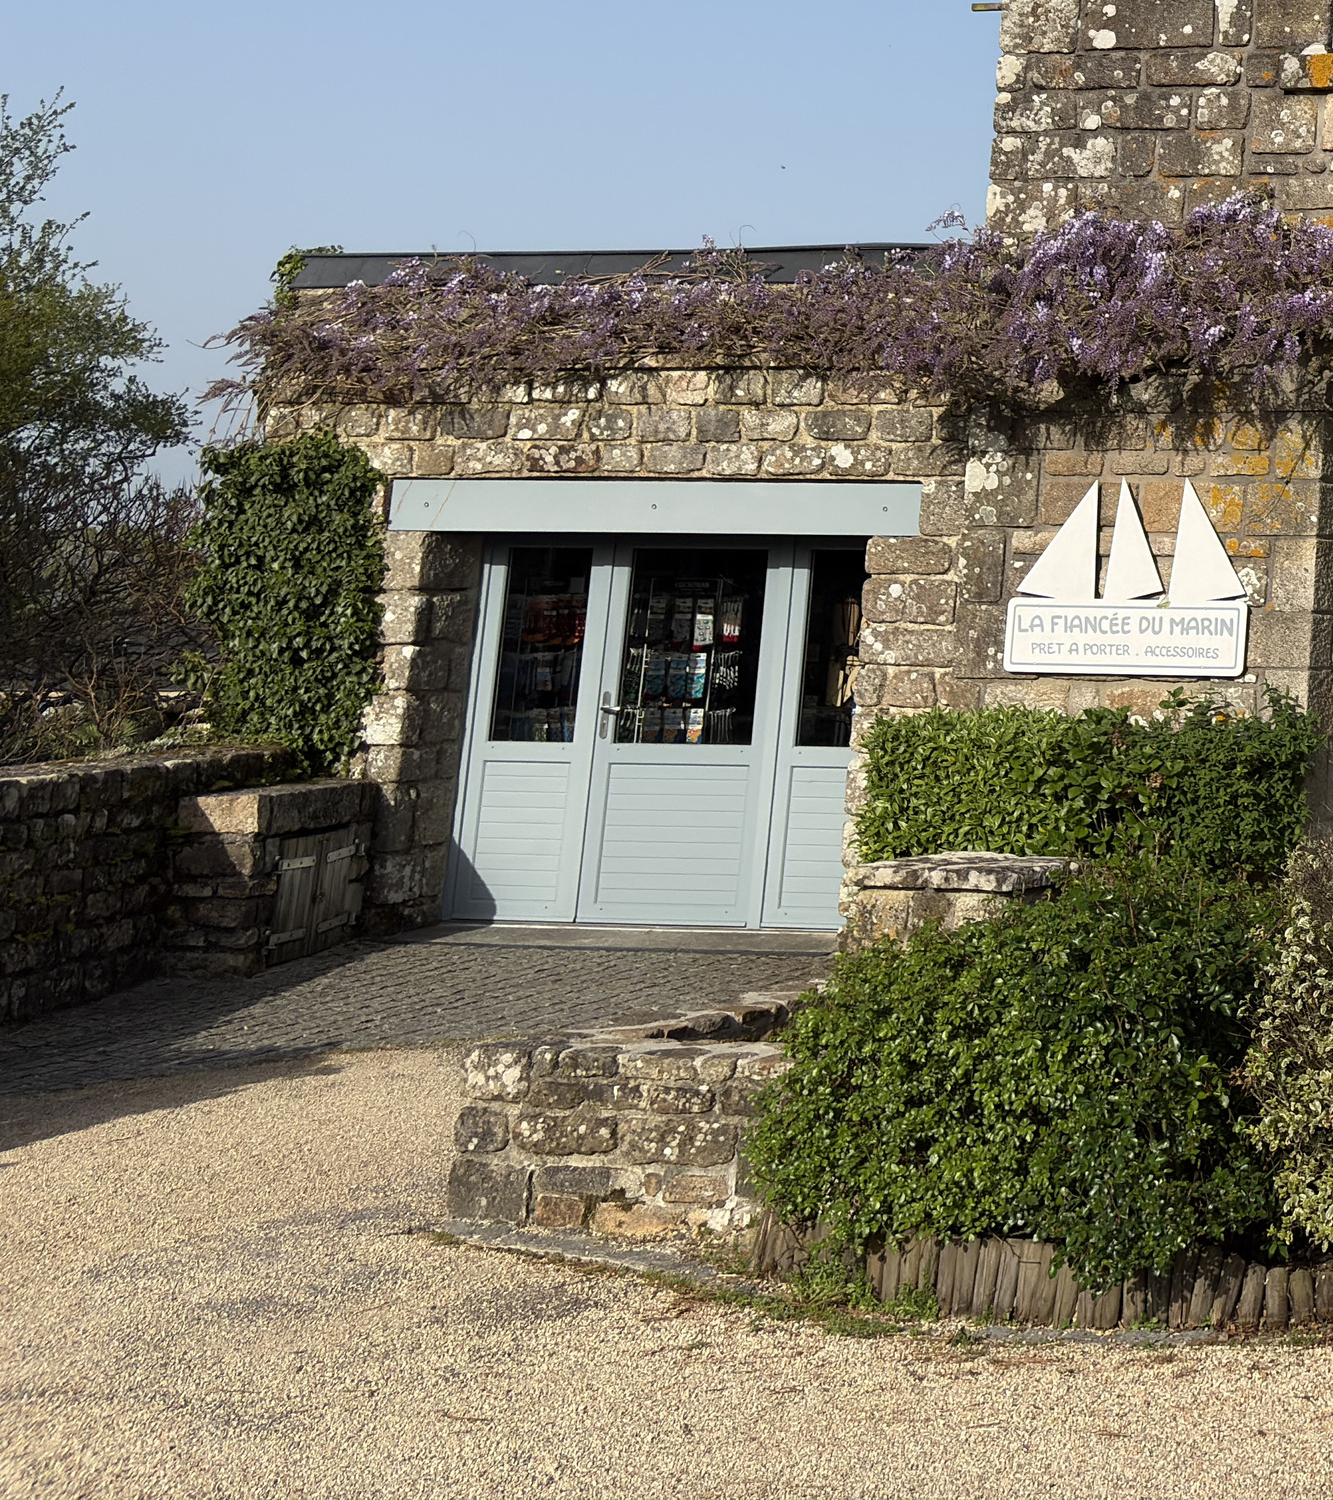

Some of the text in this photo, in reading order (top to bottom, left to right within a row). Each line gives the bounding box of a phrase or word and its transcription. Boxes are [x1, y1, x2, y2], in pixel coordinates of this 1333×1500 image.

[1017, 612, 1234, 637] LA FIANCÉE DU MARIN
[1031, 642, 1065, 655] PRET
[1067, 642, 1079, 655] A
[1083, 643, 1130, 656] PORTER
[1144, 645, 1220, 659] ACCESSOIRES
